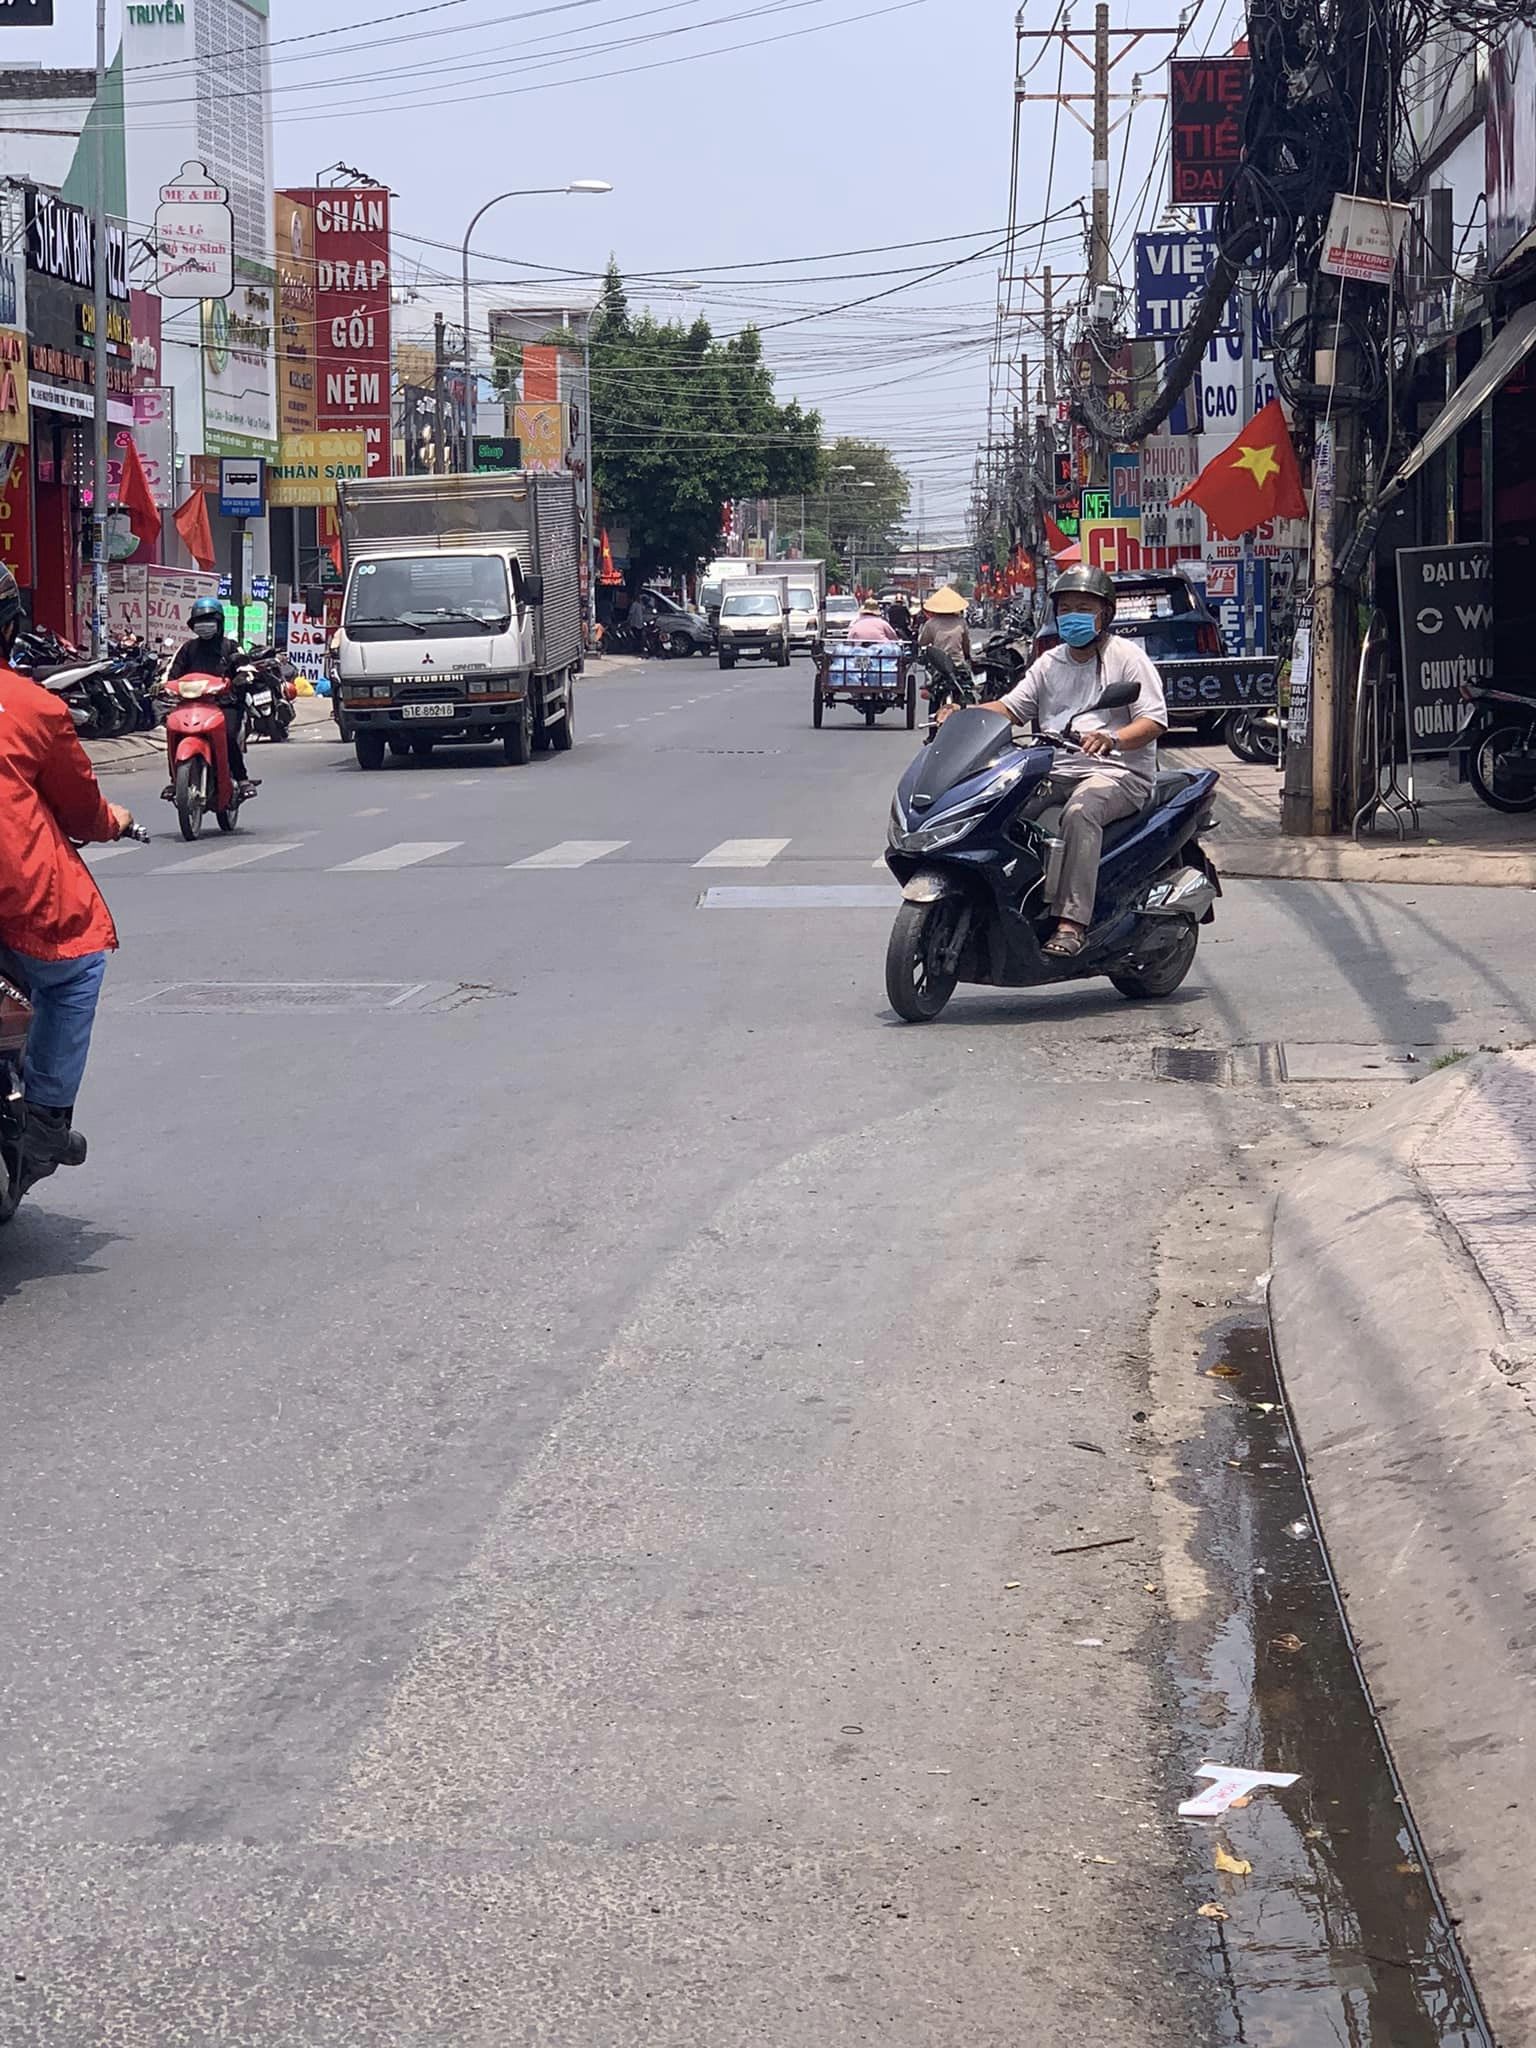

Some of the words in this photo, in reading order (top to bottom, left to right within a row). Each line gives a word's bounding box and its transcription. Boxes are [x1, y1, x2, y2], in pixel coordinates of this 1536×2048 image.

[1176, 69, 1250, 112] VIỆ
[1176, 116, 1240, 158] TIẾ
[189, 190, 199, 201] &
[316, 194, 384, 233] CHĂN
[318, 259, 386, 291] DRAP
[331, 304, 375, 349] GỐI
[327, 365, 381, 412] NỆM
[1204, 384, 1238, 418] CAO
[1253, 372, 1276, 414] ẤP
[272, 461, 319, 479] NHÂN
[1422, 562, 1454, 588] ĐẠI
[288, 649, 323, 665] NHÂN
[300, 666, 320, 681] ÂM
[1420, 654, 1476, 691] CHUYÊN
[392, 674, 464, 684] MITSUBISHI
